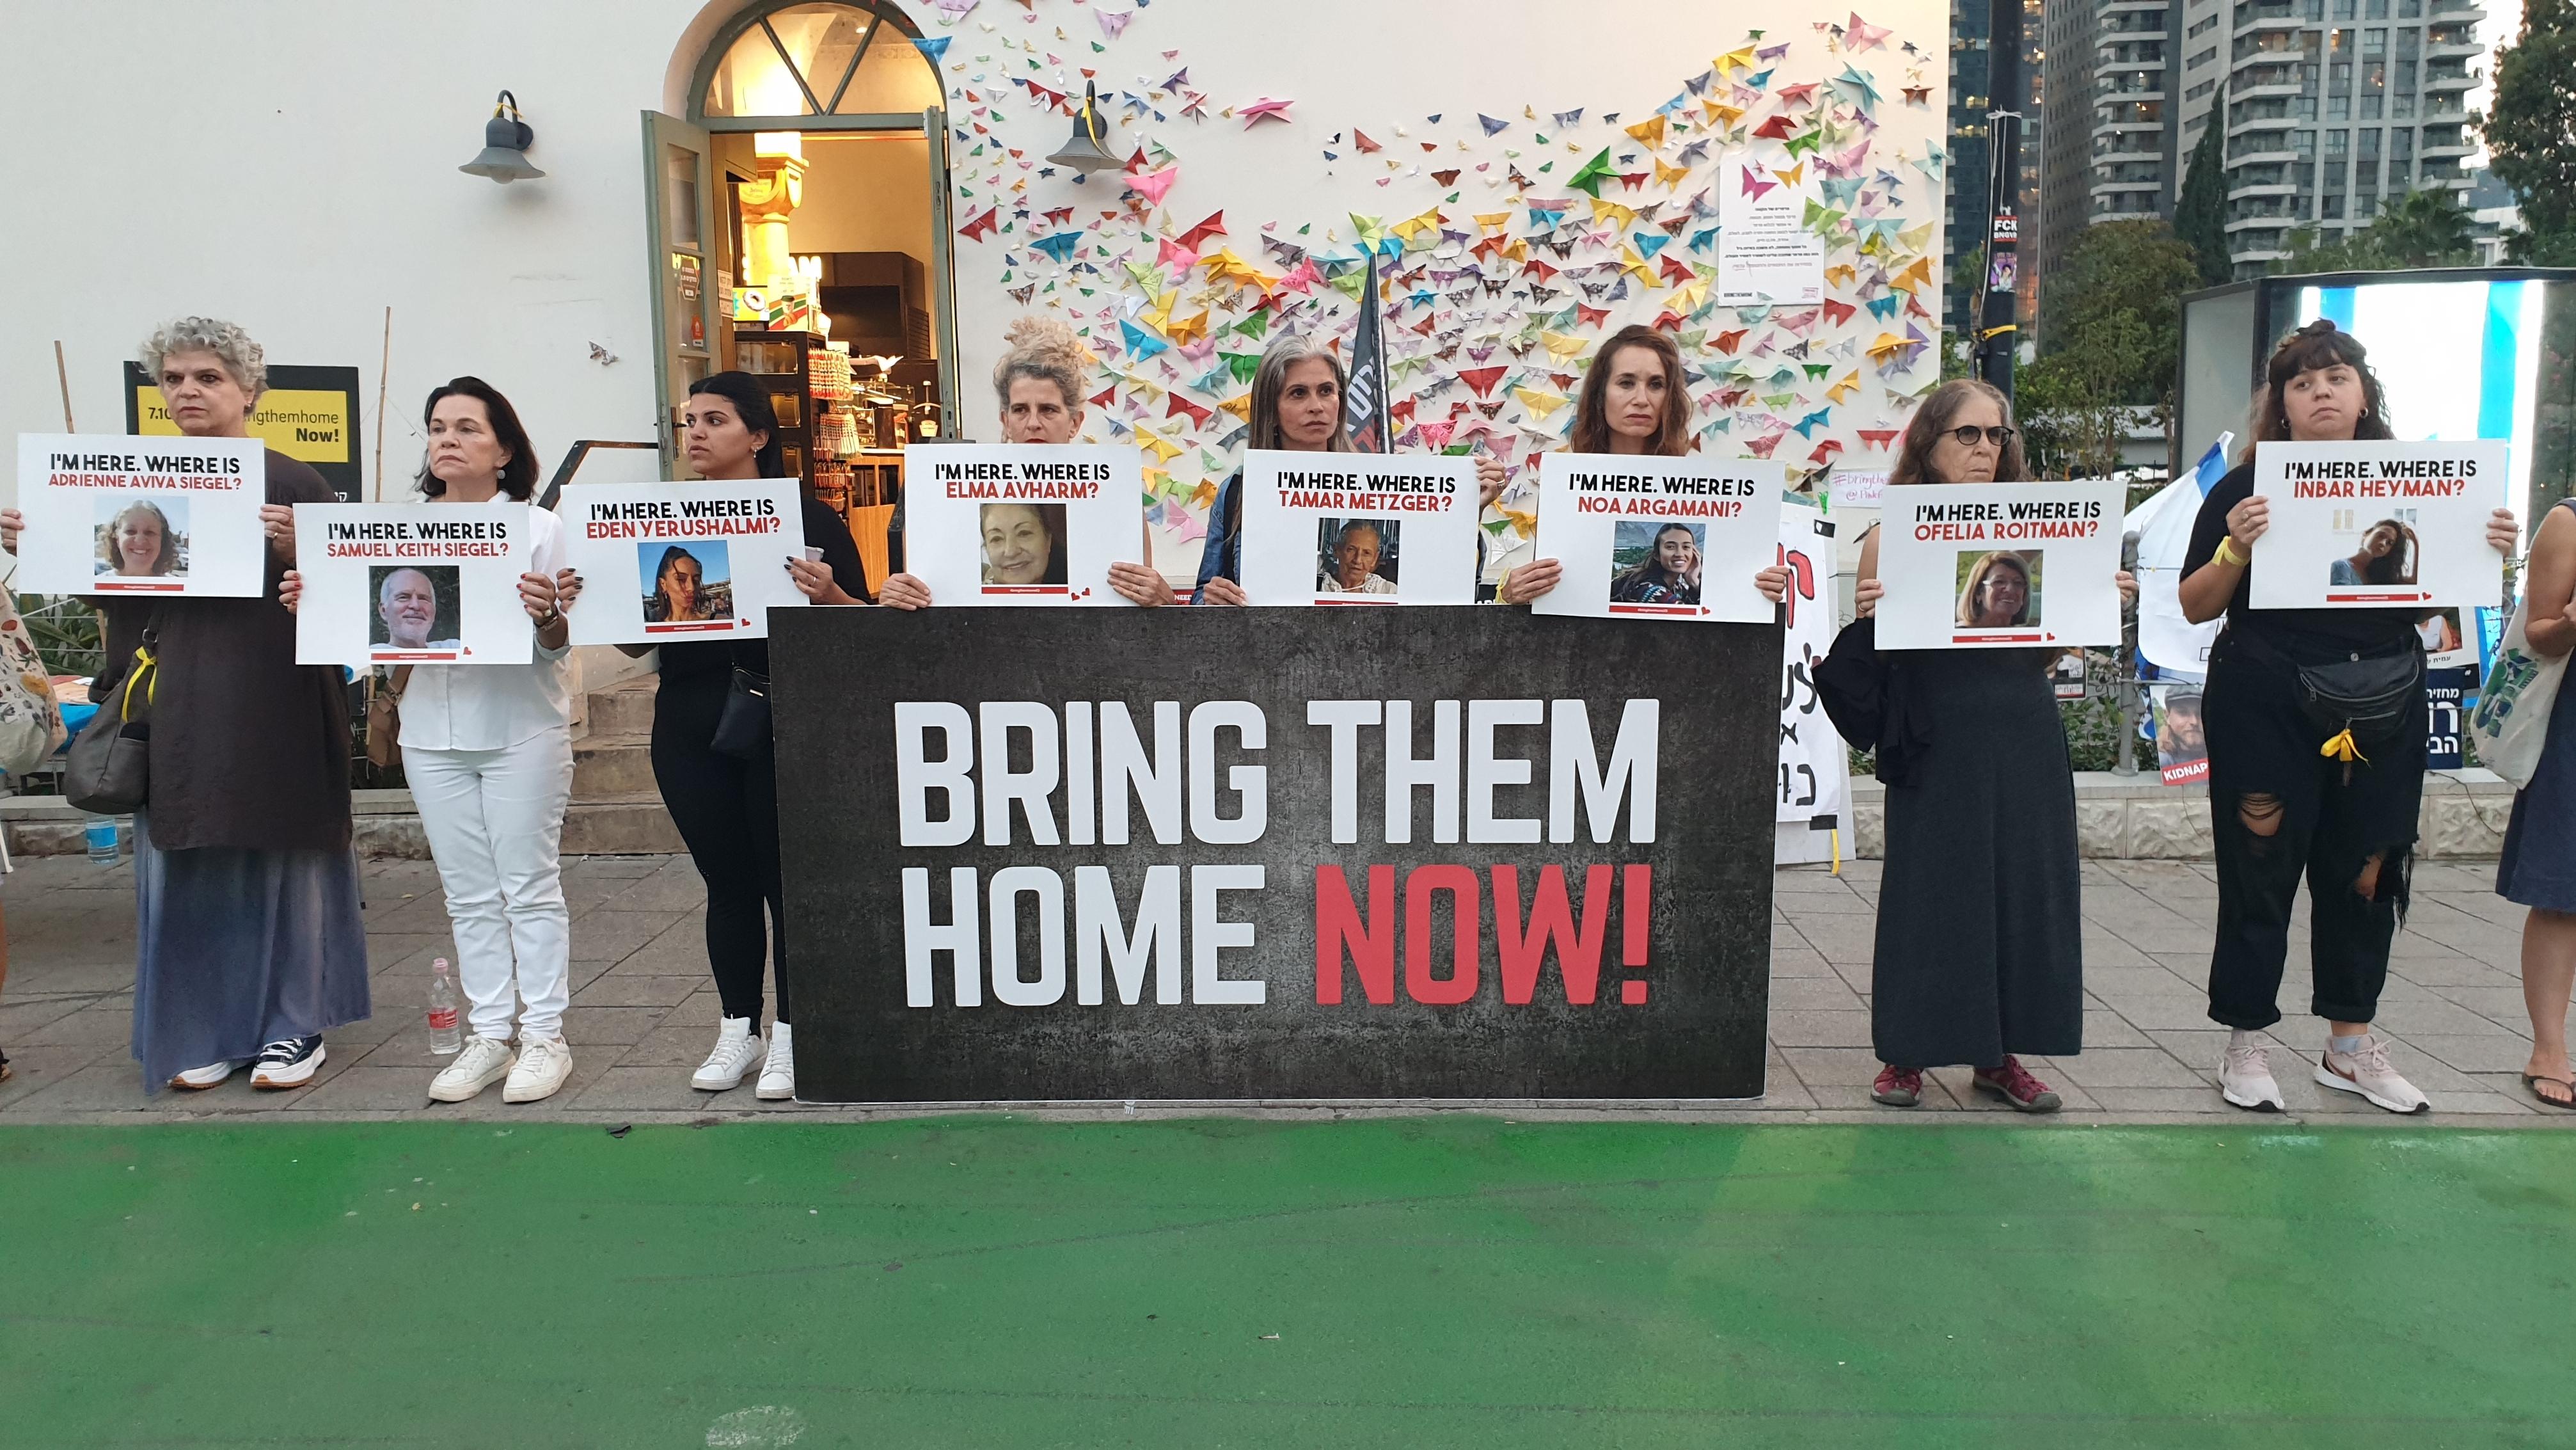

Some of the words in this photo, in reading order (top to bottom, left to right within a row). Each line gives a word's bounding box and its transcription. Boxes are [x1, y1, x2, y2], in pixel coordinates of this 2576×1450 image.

[1994, 219, 2018, 231] FCK
[296, 427, 339, 442] Now!
[51, 454, 79, 470] I'M
[84, 455, 140, 471] HERE.
[145, 456, 217, 473] WHERE
[223, 458, 240, 474] IS
[936, 464, 961, 479] I'M
[965, 464, 1017, 479] HERE.
[1021, 464, 1089, 480] WHERE
[1094, 465, 1110, 480] IS
[2286, 463, 2313, 479] I'M
[2318, 462, 2374, 479] HERE.
[2379, 461, 2454, 477] WHERE
[2460, 460, 2477, 476] IS
[49, 474, 127, 488] ADRIENNE
[130, 476, 177, 489] AVIVA
[181, 477, 242, 490] SIEGEL?
[947, 481, 999, 498] ELMA
[1004, 481, 1100, 498] AVHARM?
[1278, 472, 1304, 488] I'M
[1309, 473, 1361, 490] HERE.
[1366, 475, 1434, 492] WHERE
[1439, 477, 1456, 493] IS
[1570, 474, 1597, 491] I'M
[1602, 475, 1657, 493] HERE.
[1663, 477, 1733, 495] WHERE
[1737, 479, 1755, 496] IS
[2295, 481, 2355, 498] INBAR
[2360, 479, 2465, 498] HEYMAN?
[591, 504, 619, 520] I'M
[622, 502, 677, 519] HERE.
[680, 500, 752, 518] WHERE
[757, 499, 775, 515] IS
[1279, 491, 1345, 509] TAMAR
[1349, 493, 1452, 512] METZGER?
[1578, 497, 1622, 514] NOA
[1627, 498, 1742, 517] ARGAMANI?
[1916, 505, 1943, 522] I'M
[1948, 504, 2003, 521] HERE.
[2009, 502, 2079, 519] WHERE
[2084, 502, 2101, 518] IS
[328, 523, 356, 539] I'M
[360, 523, 413, 539] HERE.
[416, 523, 485, 539] WHERE
[490, 523, 507, 539] IS
[587, 522, 636, 540] EDEN
[640, 517, 781, 537] YERUSHALMI?
[1915, 523, 1985, 541] OFELIA
[1994, 521, 2098, 539] ROITMAN?
[328, 543, 391, 557] SAMUEL
[397, 543, 442, 557] KEITH
[446, 543, 509, 557] SIEGEL?
[895, 701, 1267, 846] BRING
[1308, 699, 1659, 843] THEM
[902, 864, 1265, 1007] HOME
[1315, 863, 1653, 1006] NOW!
